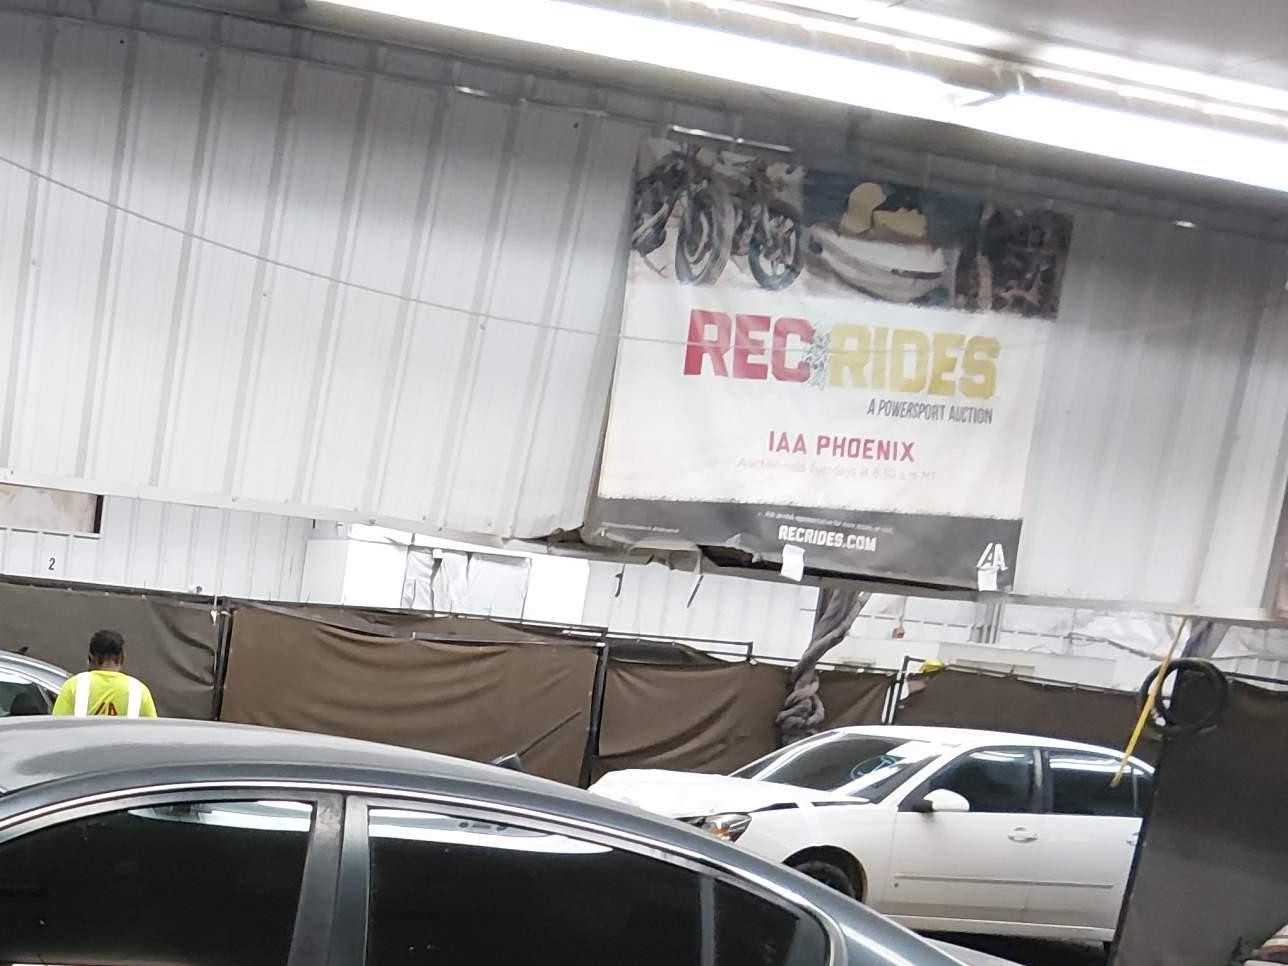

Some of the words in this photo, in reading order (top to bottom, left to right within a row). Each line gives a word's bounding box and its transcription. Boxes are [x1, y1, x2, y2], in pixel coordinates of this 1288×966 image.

[683, 308, 816, 383] REC
[827, 321, 1002, 400] RIDES
[867, 398, 876, 416] A
[877, 399, 946, 421] POWERSPORT
[948, 405, 993, 425] AUCTION
[768, 430, 808, 455] IAA
[816, 434, 915, 463] PHOENIX
[778, 524, 878, 552] RECRIDES.COM
[48, 556, 56, 571] 2
